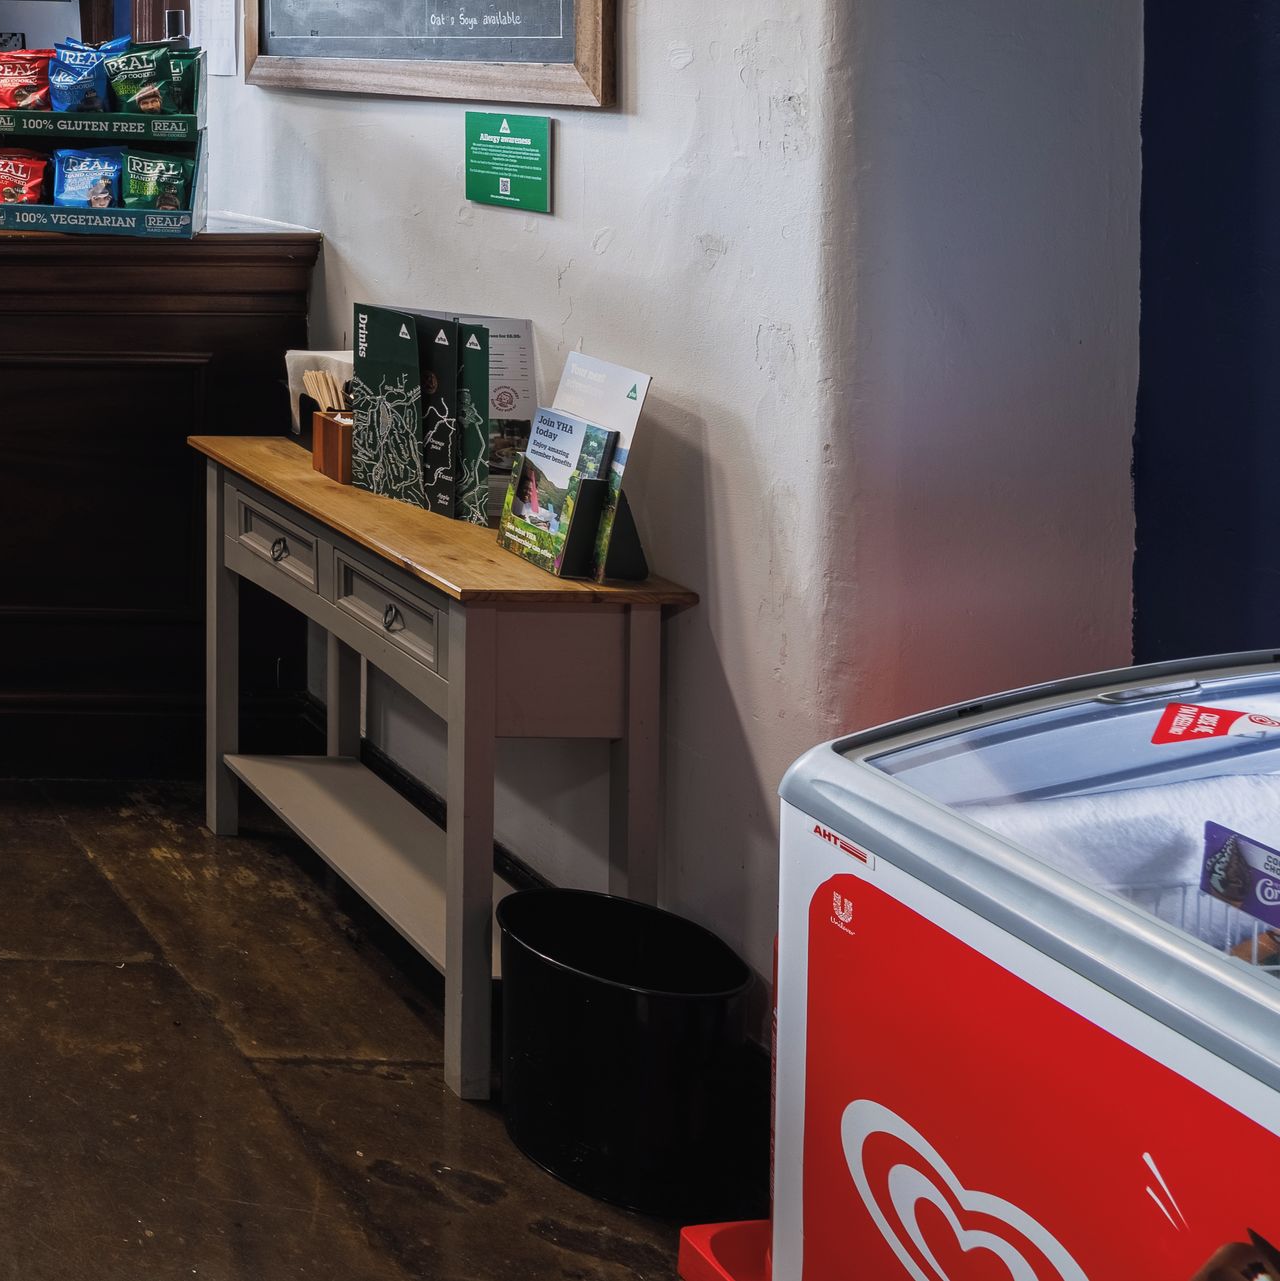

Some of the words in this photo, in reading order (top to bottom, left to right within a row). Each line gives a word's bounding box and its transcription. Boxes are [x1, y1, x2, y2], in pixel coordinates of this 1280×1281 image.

[430, 13, 446, 26] Oat
[459, 13, 478, 30] Soya
[483, 11, 522, 26] available
[107, 56, 153, 75] REAL
[22, 118, 54, 130] 100%
[57, 119, 109, 132] GLUTEN
[112, 122, 145, 133] FREE
[152, 121, 186, 133] REAL
[479, 132, 501, 144] Allergy
[500, 135, 532, 145] awareness
[67, 157, 114, 171] REAL
[131, 159, 180, 175] REAL
[15, 211, 48, 225] 100%
[50, 213, 137, 228] VEGETARIAN
[146, 216, 182, 227] REAL
[358, 312, 368, 359] Drinks
[535, 425, 559, 442] today
[538, 415, 556, 429] Join
[556, 420, 574, 435] YHA
[530, 448, 551, 461] member
[551, 454, 573, 469] benefits
[532, 439, 547, 451] Enjoy
[547, 445, 570, 460] amazing
[813, 824, 840, 846] AHT
[830, 915, 856, 936] Unilever
